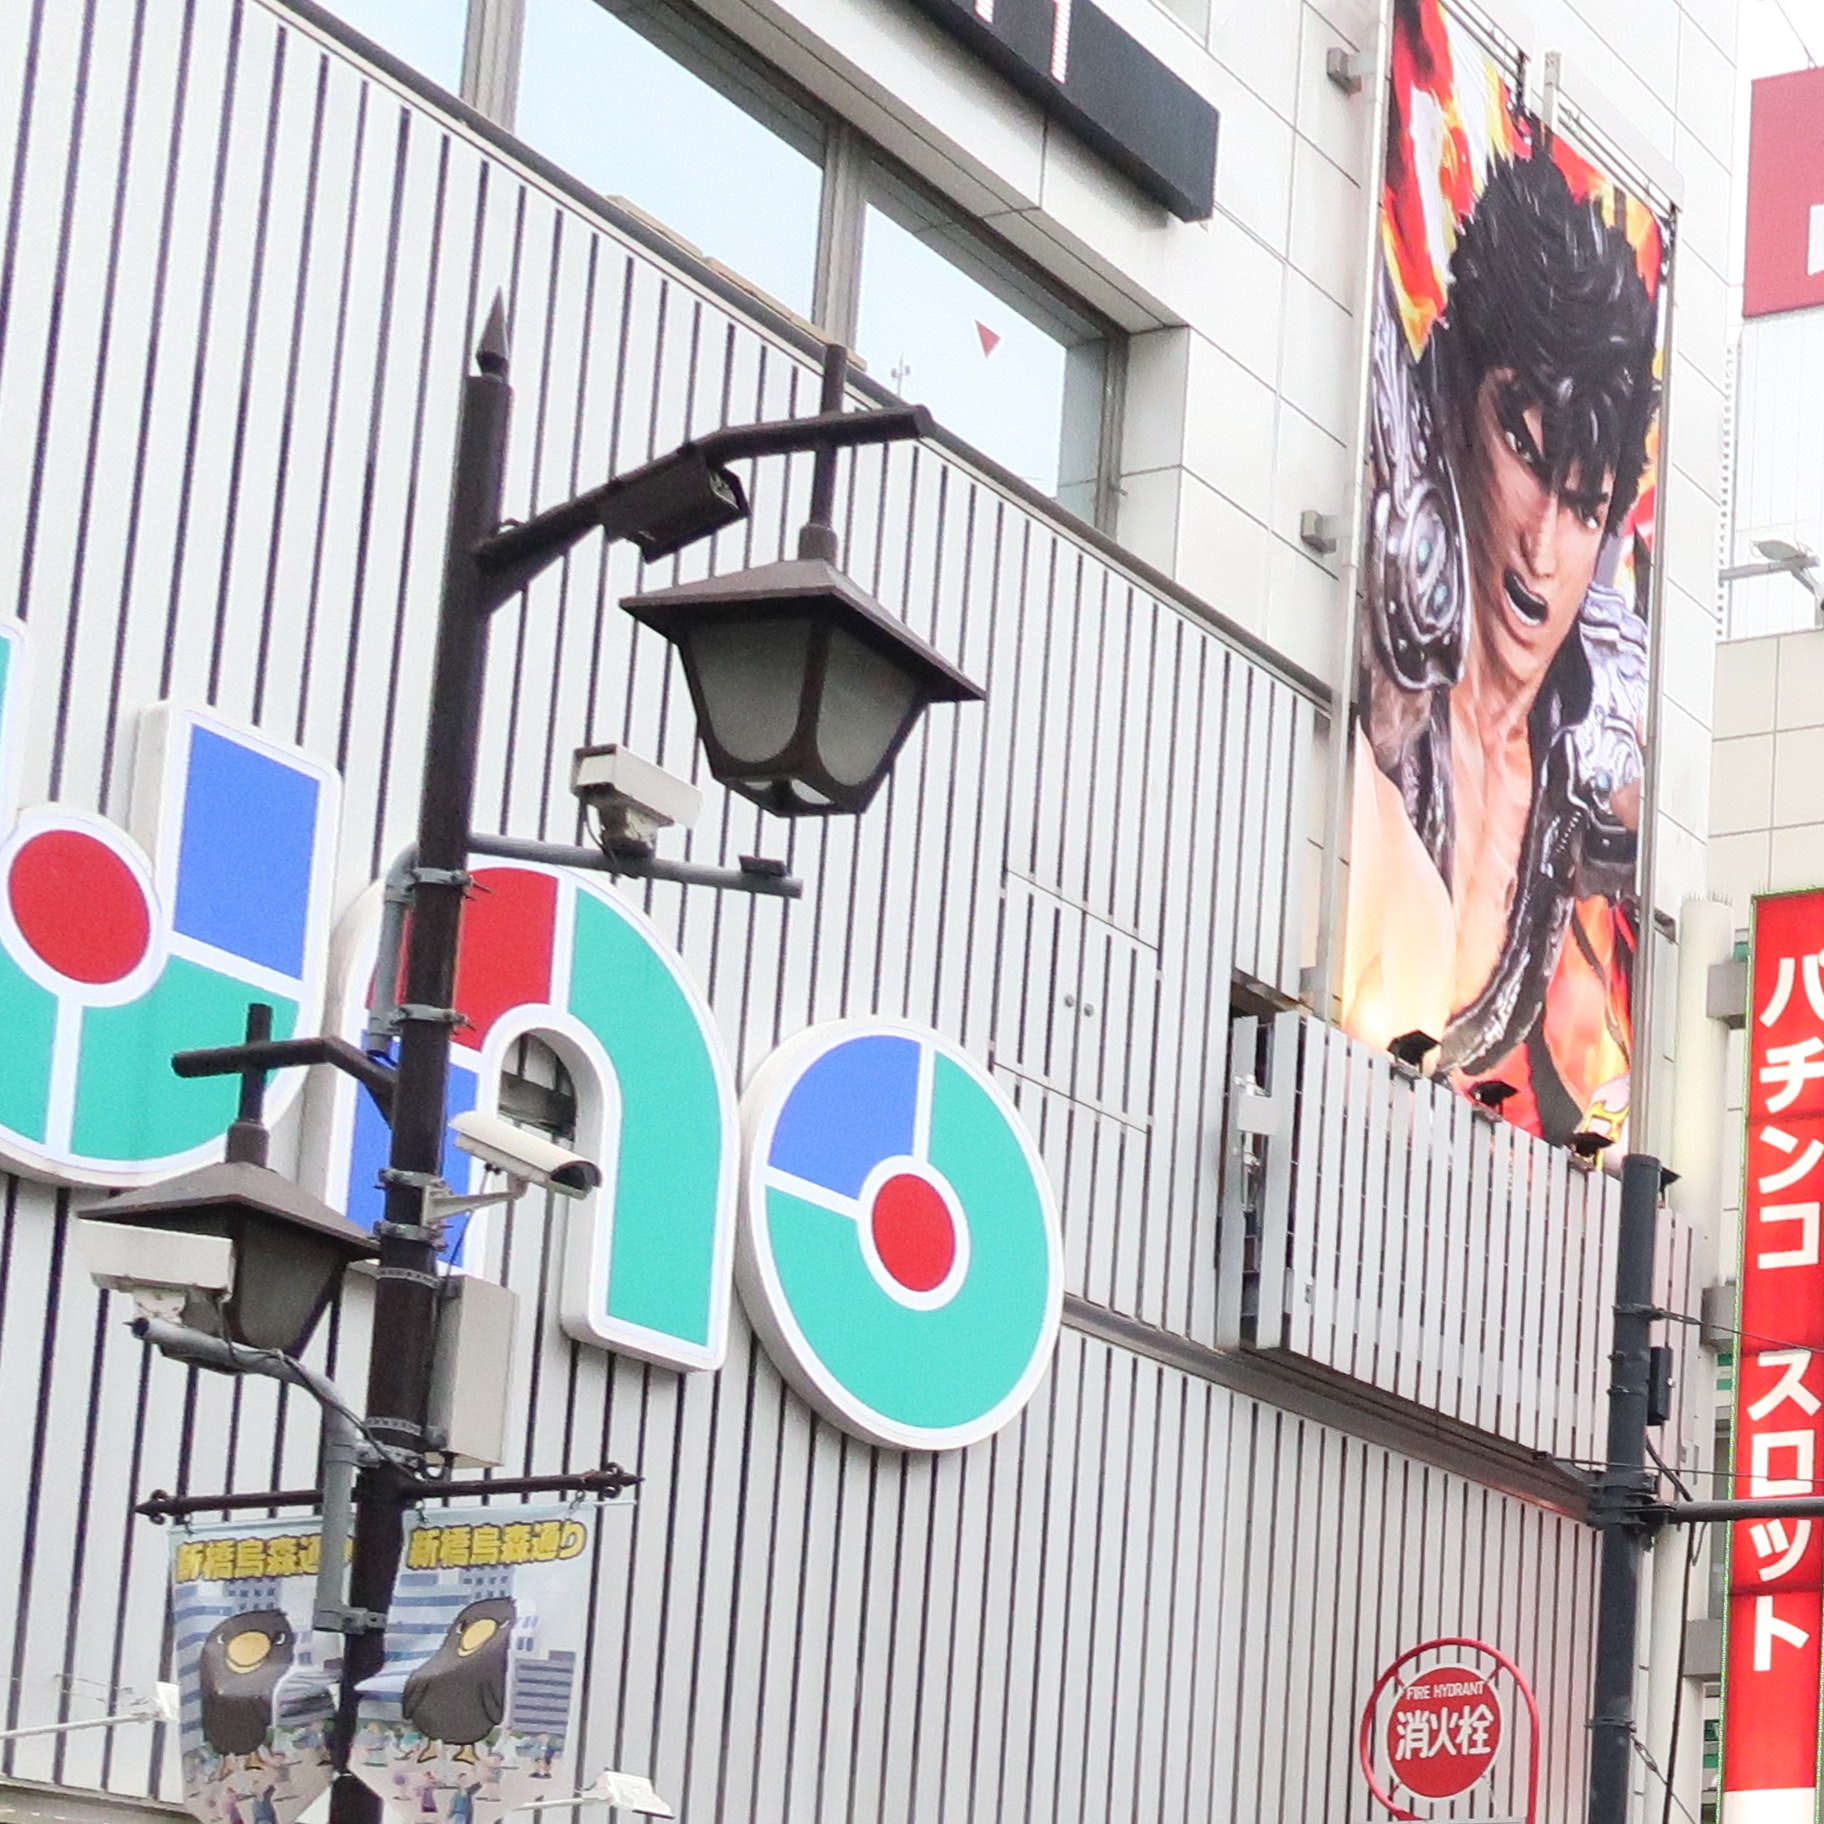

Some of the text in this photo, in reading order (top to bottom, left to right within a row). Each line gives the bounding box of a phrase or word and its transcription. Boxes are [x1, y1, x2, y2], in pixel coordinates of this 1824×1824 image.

[1749, 1350, 1819, 1672] スロット
[176, 1534, 353, 1584] 新橋烏森通
[1406, 1681, 1485, 1700] FIRE HYDRANT
[1394, 1704, 1495, 1761] 消火栓
